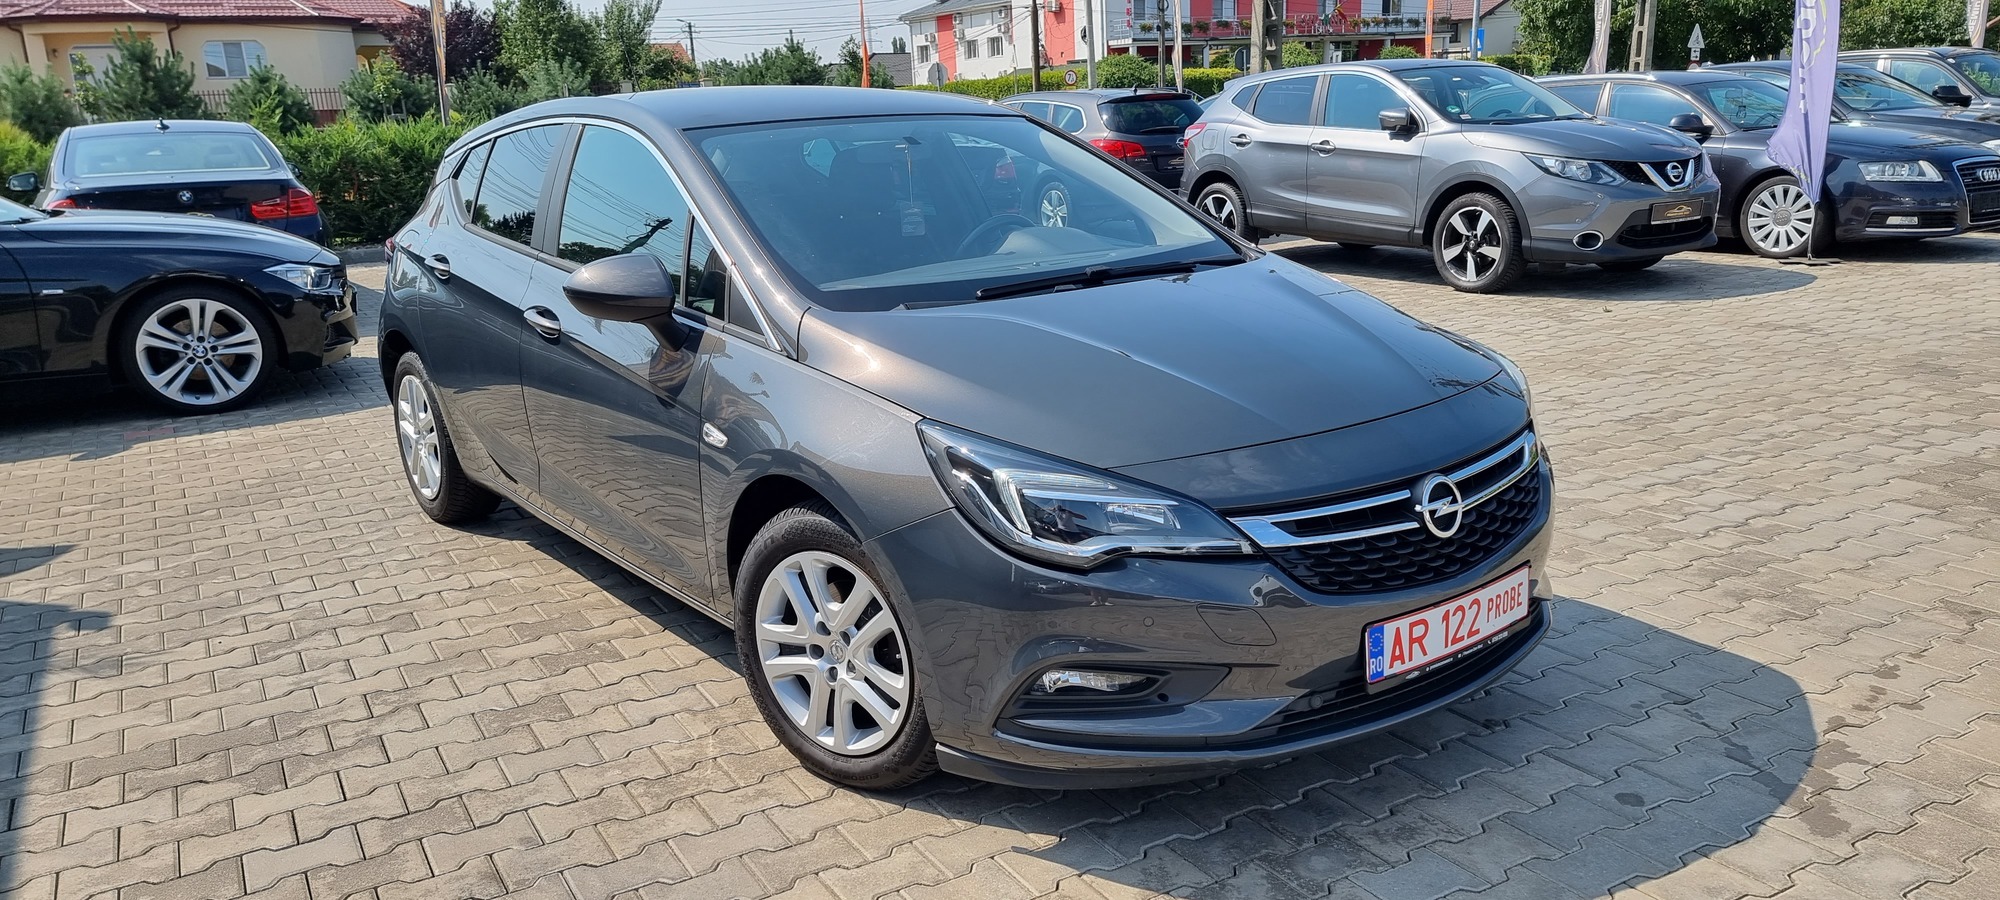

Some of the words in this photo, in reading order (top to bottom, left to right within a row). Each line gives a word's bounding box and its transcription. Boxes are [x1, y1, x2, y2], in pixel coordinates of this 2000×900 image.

[1388, 618, 1429, 670] AR
[1441, 597, 1482, 649] 122
[1486, 581, 1523, 624] PROBE
[1370, 655, 1383, 676] RO
